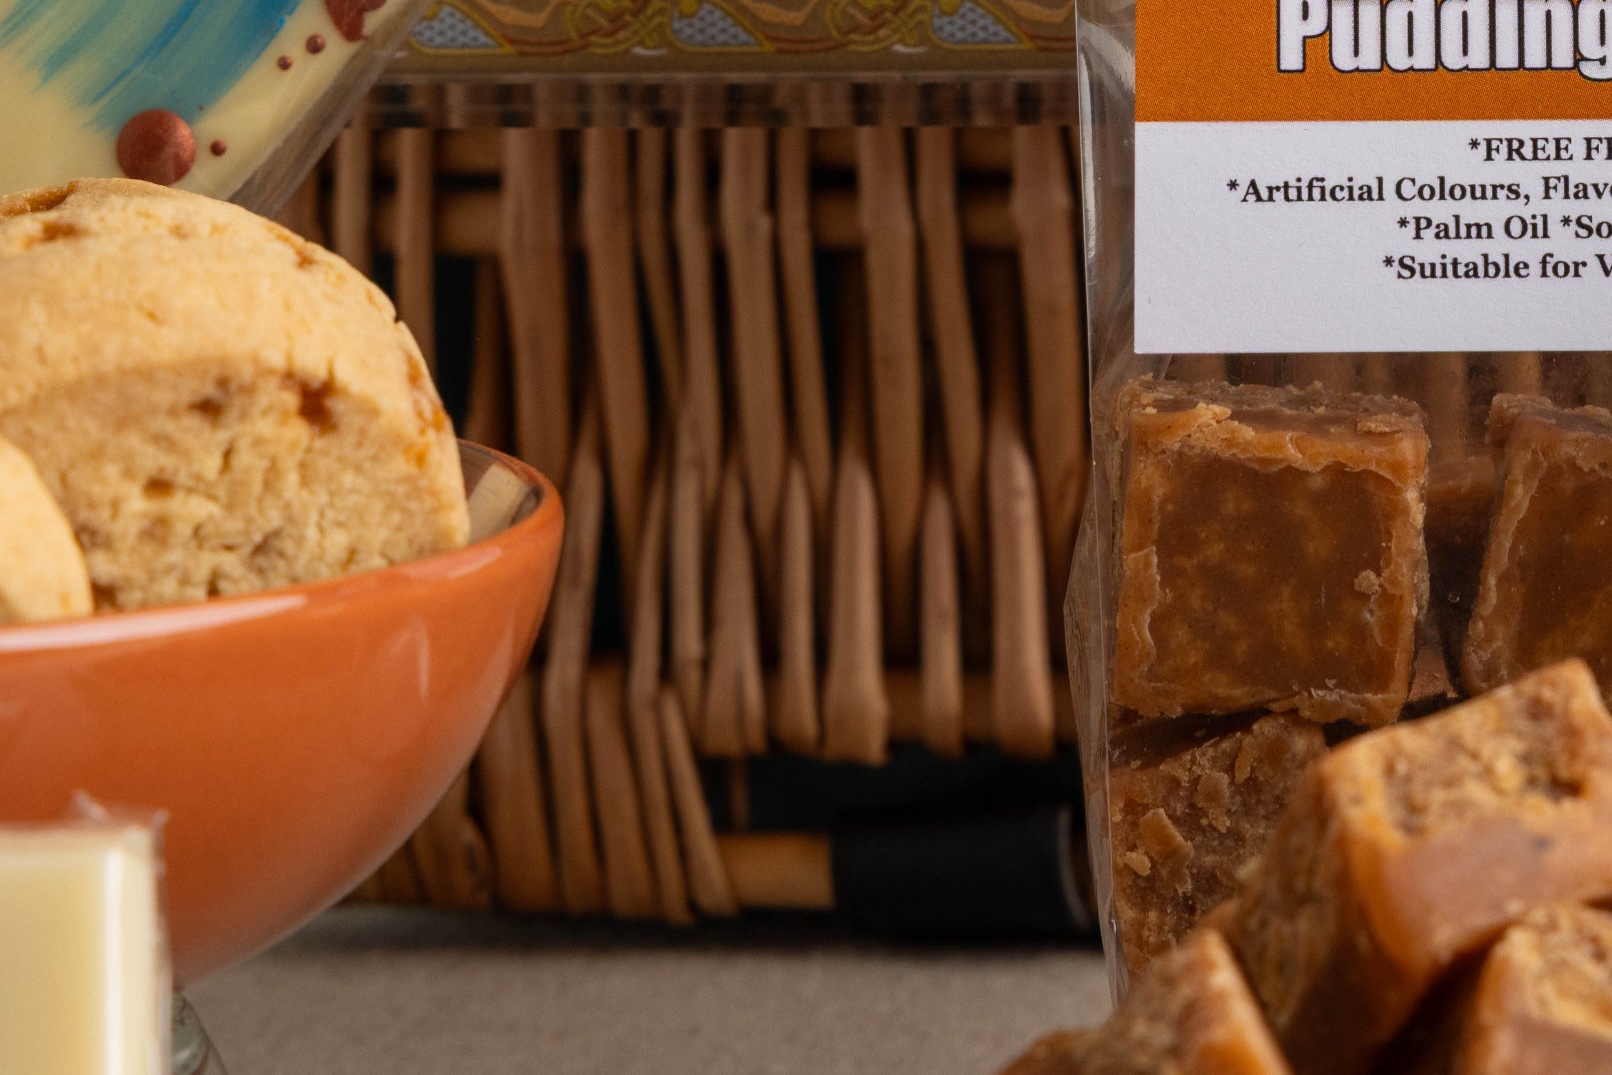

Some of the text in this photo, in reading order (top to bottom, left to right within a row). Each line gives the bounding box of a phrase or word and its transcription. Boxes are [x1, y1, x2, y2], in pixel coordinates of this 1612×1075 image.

[1395, 175, 1532, 206] Colours,
[1504, 214, 1551, 241] Oil
[1540, 252, 1588, 280] for
